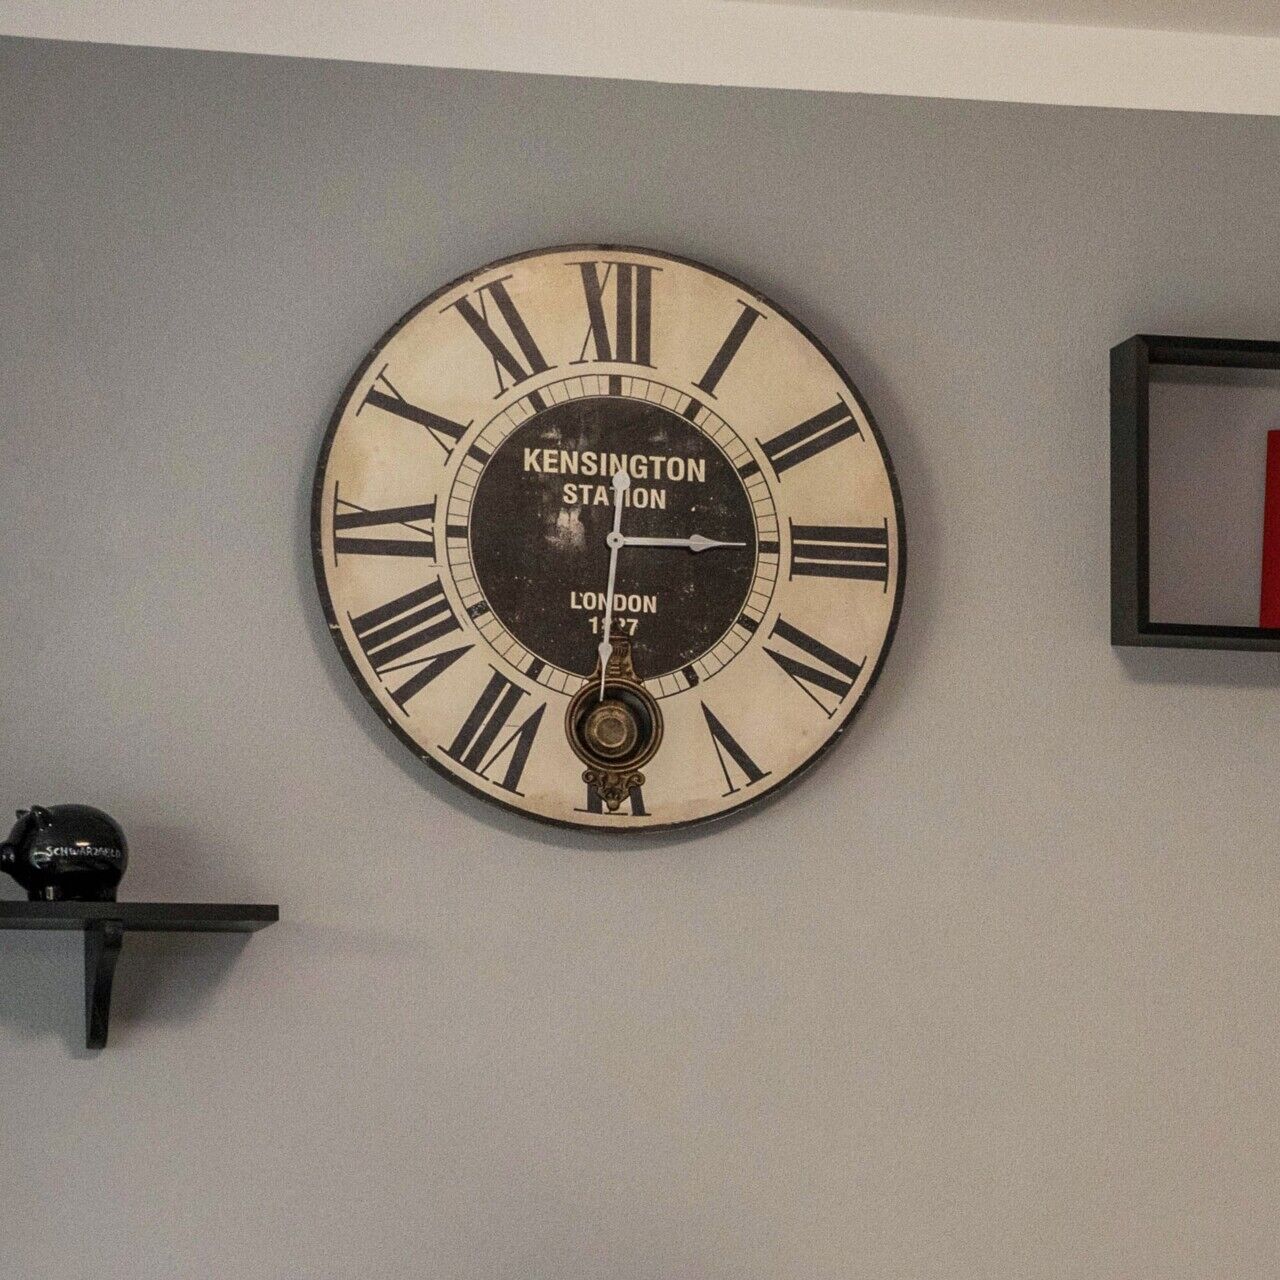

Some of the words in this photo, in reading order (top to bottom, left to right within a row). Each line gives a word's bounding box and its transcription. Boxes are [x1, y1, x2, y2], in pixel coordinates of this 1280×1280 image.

[439, 274, 558, 399] XI
[565, 261, 663, 368] XII
[691, 298, 767, 399] I
[356, 363, 475, 466] X
[524, 448, 706, 482] KENSINGTON
[754, 393, 866, 482] II
[334, 480, 437, 567] IX
[789, 518, 889, 592] III
[347, 574, 476, 718] VIII
[762, 613, 868, 719] IV
[437, 663, 547, 797] VII
[700, 699, 773, 796] V
